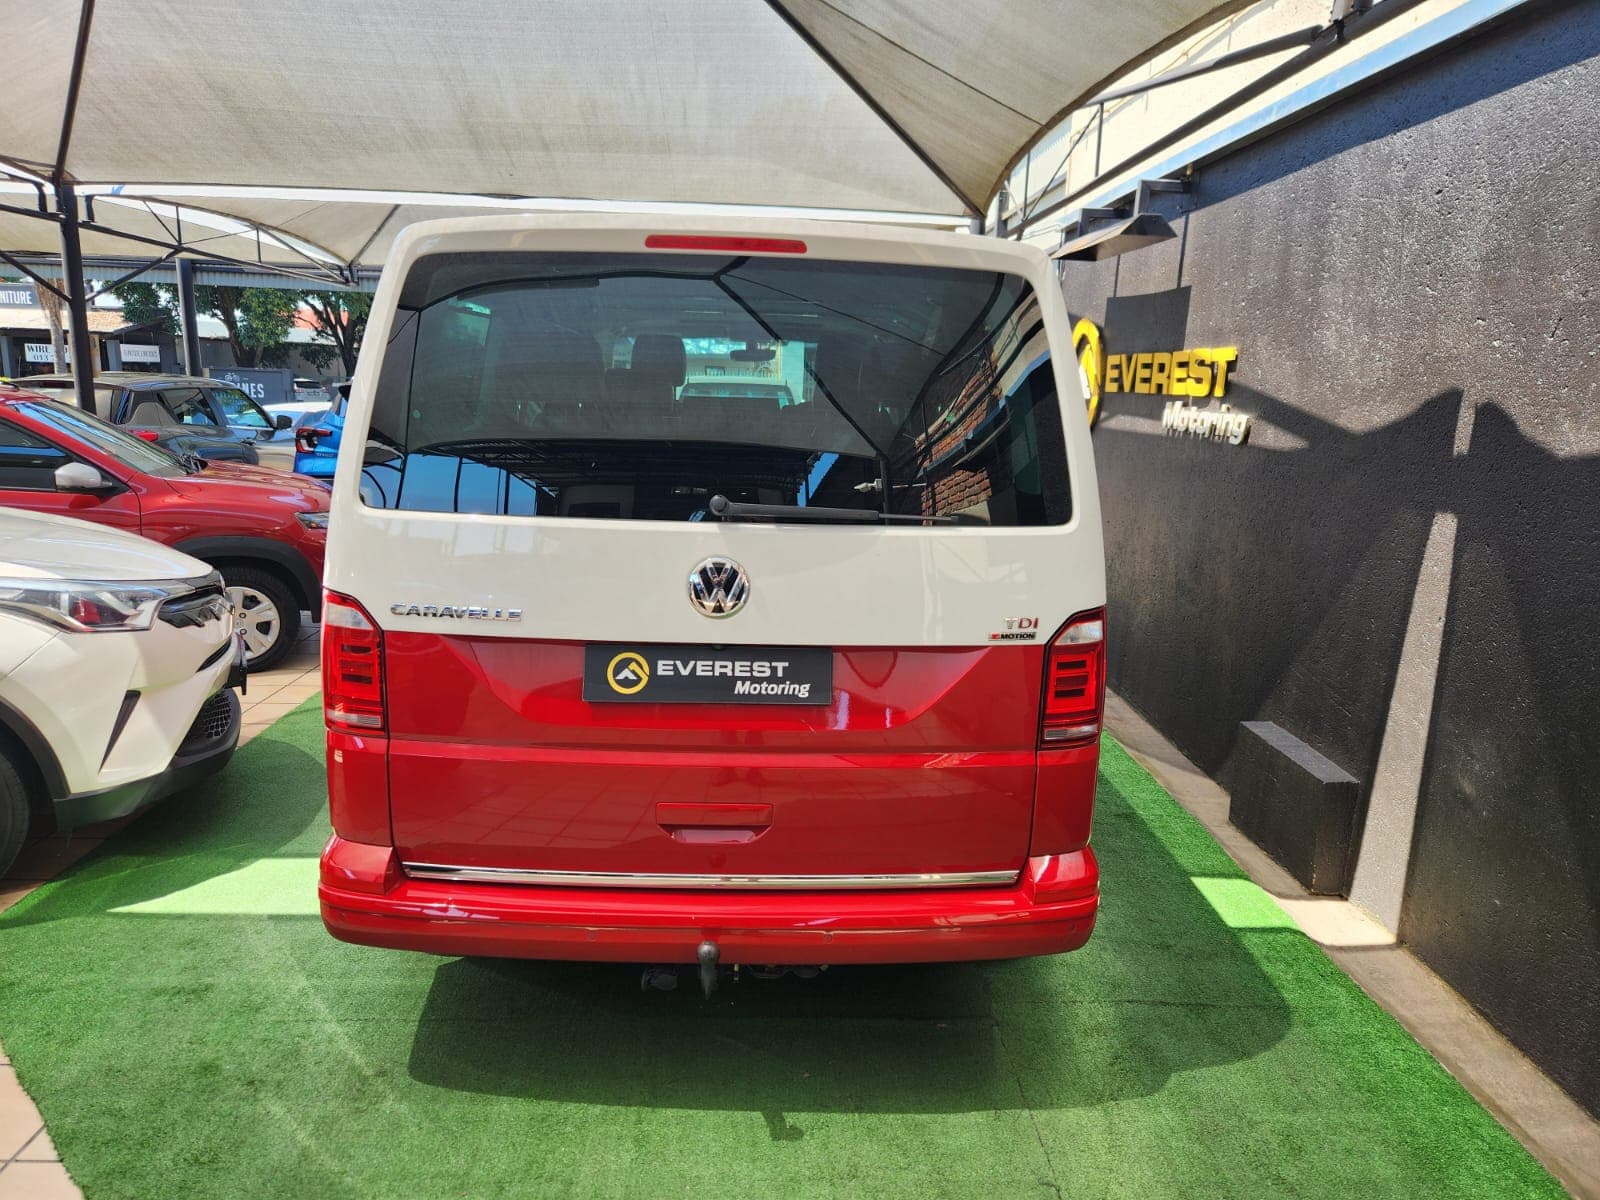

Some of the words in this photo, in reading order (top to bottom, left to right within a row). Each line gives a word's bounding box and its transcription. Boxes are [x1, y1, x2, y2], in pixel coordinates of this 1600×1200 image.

[1104, 347, 1238, 397] EVEREST
[1162, 400, 1249, 445] Motoring
[390, 602, 522, 621] CARAVELLE
[1004, 617, 1039, 630] TDI
[656, 660, 790, 678] EVEREST
[734, 680, 811, 698] Motoring
